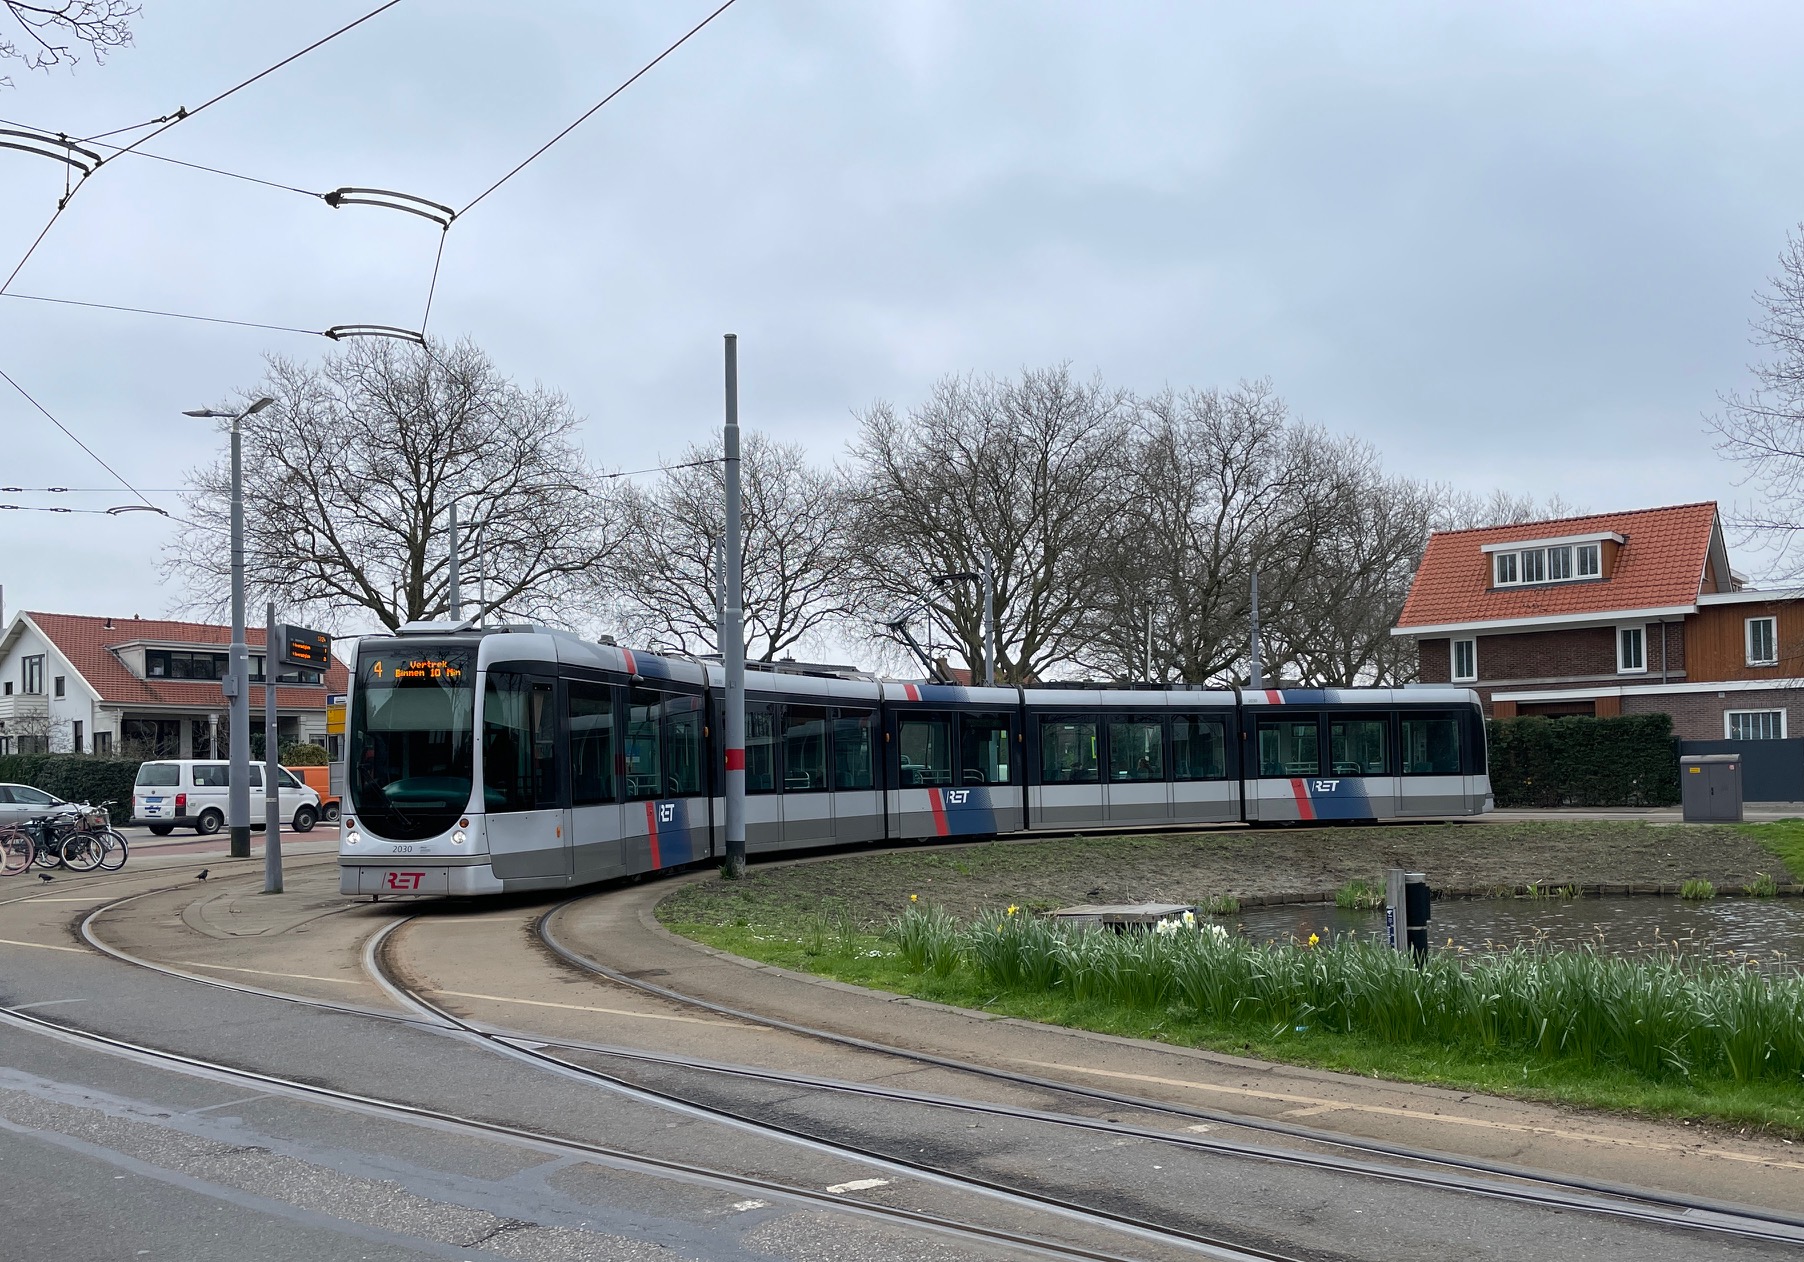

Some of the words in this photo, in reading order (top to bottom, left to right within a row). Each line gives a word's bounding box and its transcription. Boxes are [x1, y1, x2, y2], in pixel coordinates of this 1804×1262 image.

[373, 660, 383, 678] 4
[409, 660, 448, 669] Vertrek
[395, 667, 425, 678] Binnen
[430, 668, 441, 677] 10
[446, 668, 461, 677] Min
[1315, 780, 1340, 792] RET
[949, 790, 970, 804] RET
[659, 803, 675, 822] RET
[392, 845, 413, 853] 2030
[386, 872, 426, 889] RET
